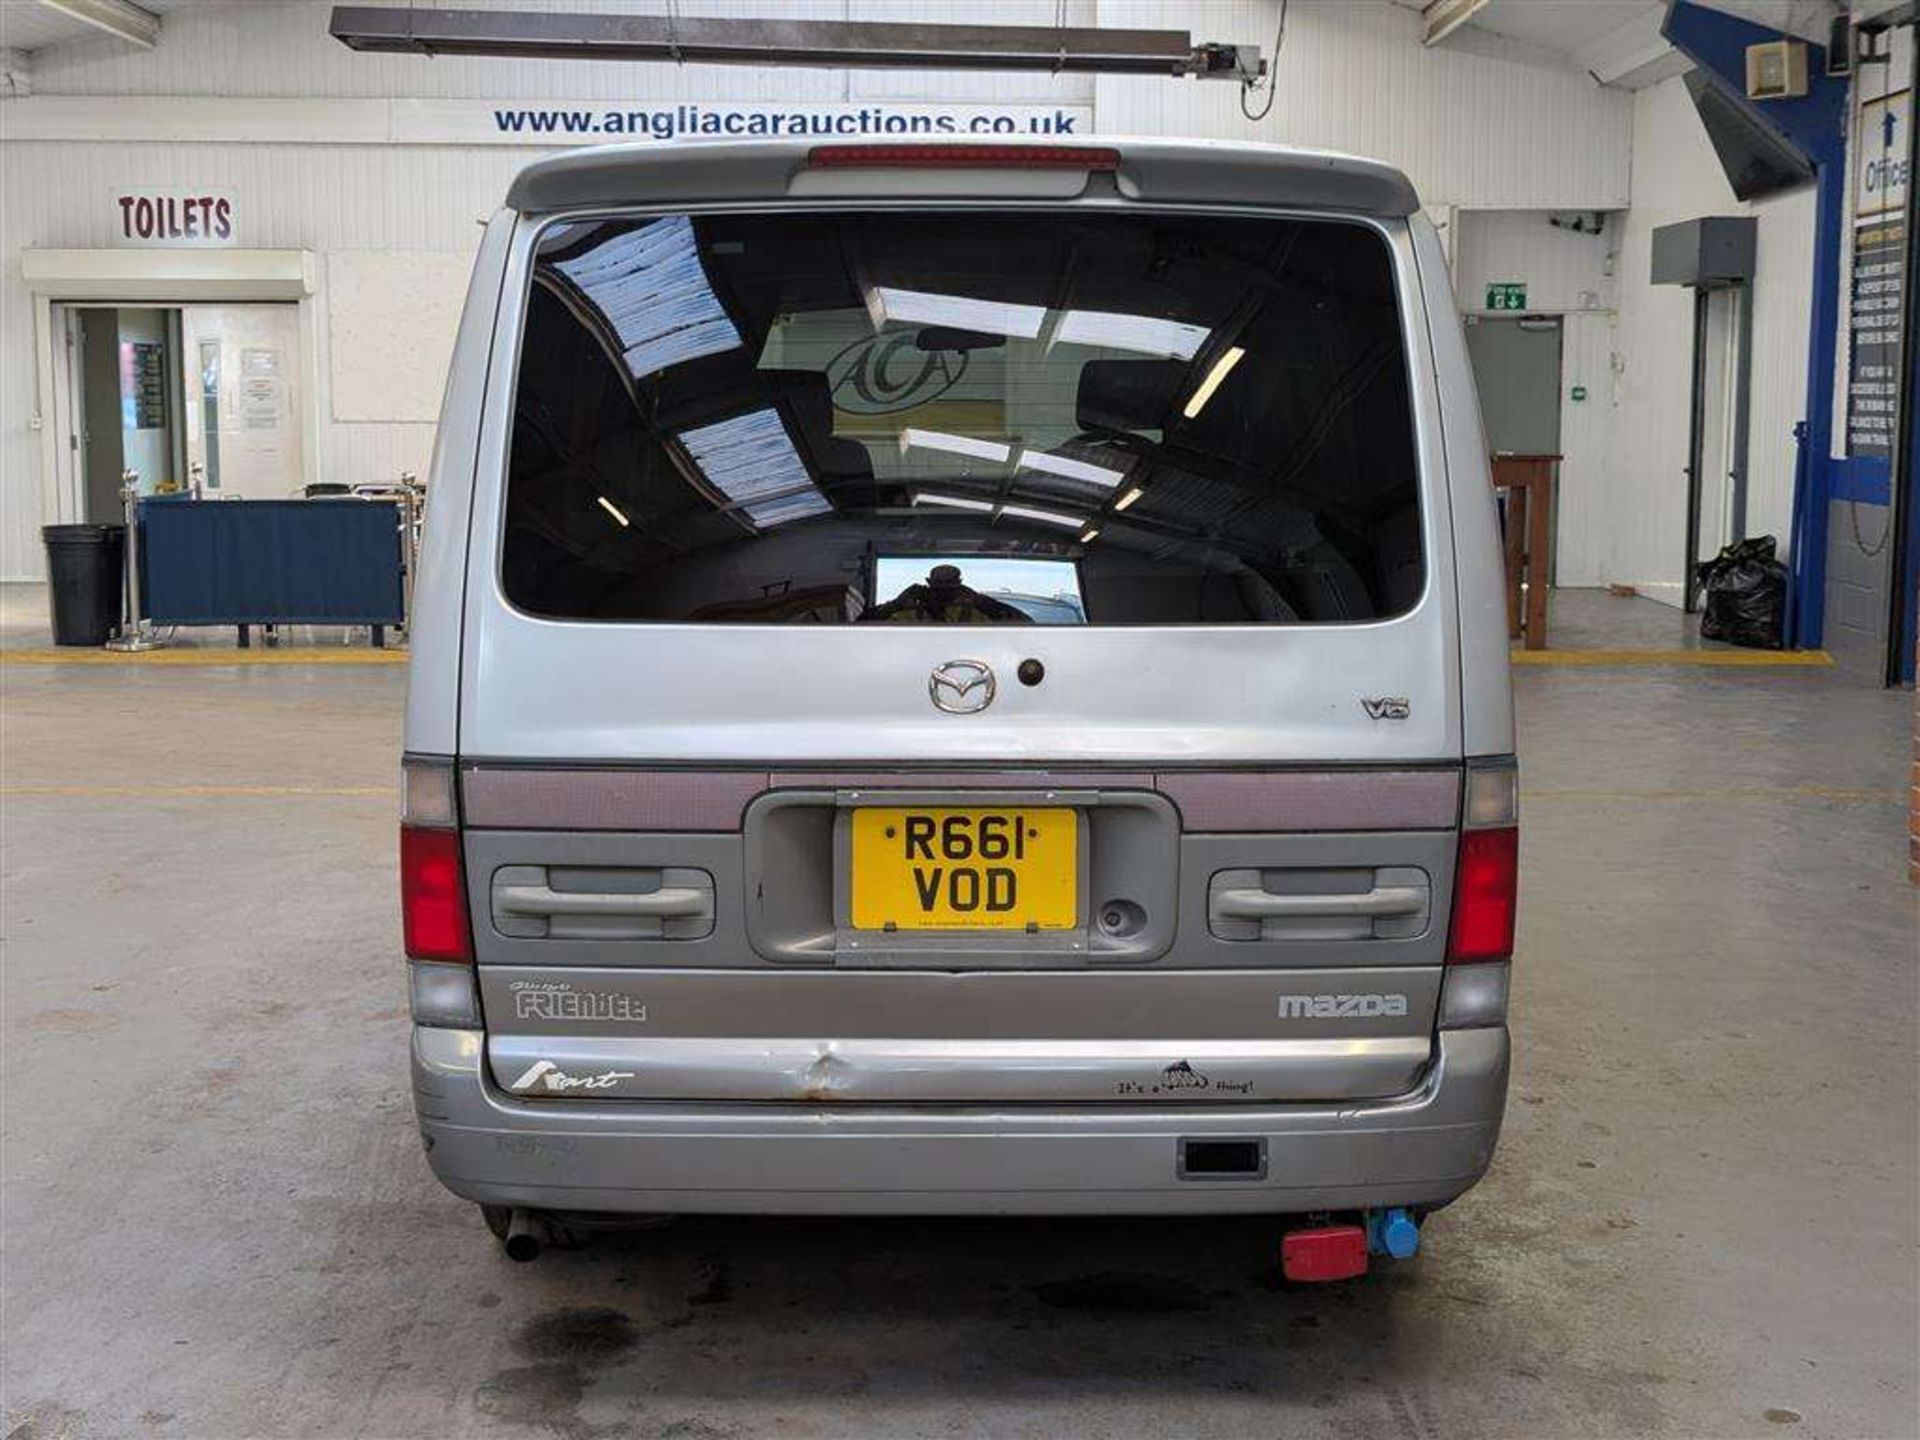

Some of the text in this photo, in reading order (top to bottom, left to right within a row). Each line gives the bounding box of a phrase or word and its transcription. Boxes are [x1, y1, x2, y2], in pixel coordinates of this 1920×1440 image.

[1865, 159, 1909, 193] Office
[118, 196, 231, 239] TOILETS
[1361, 697, 1410, 720] V6
[905, 816, 1024, 859] R661
[913, 867, 1017, 912] VOD
[1278, 994, 1407, 1018] mazda
